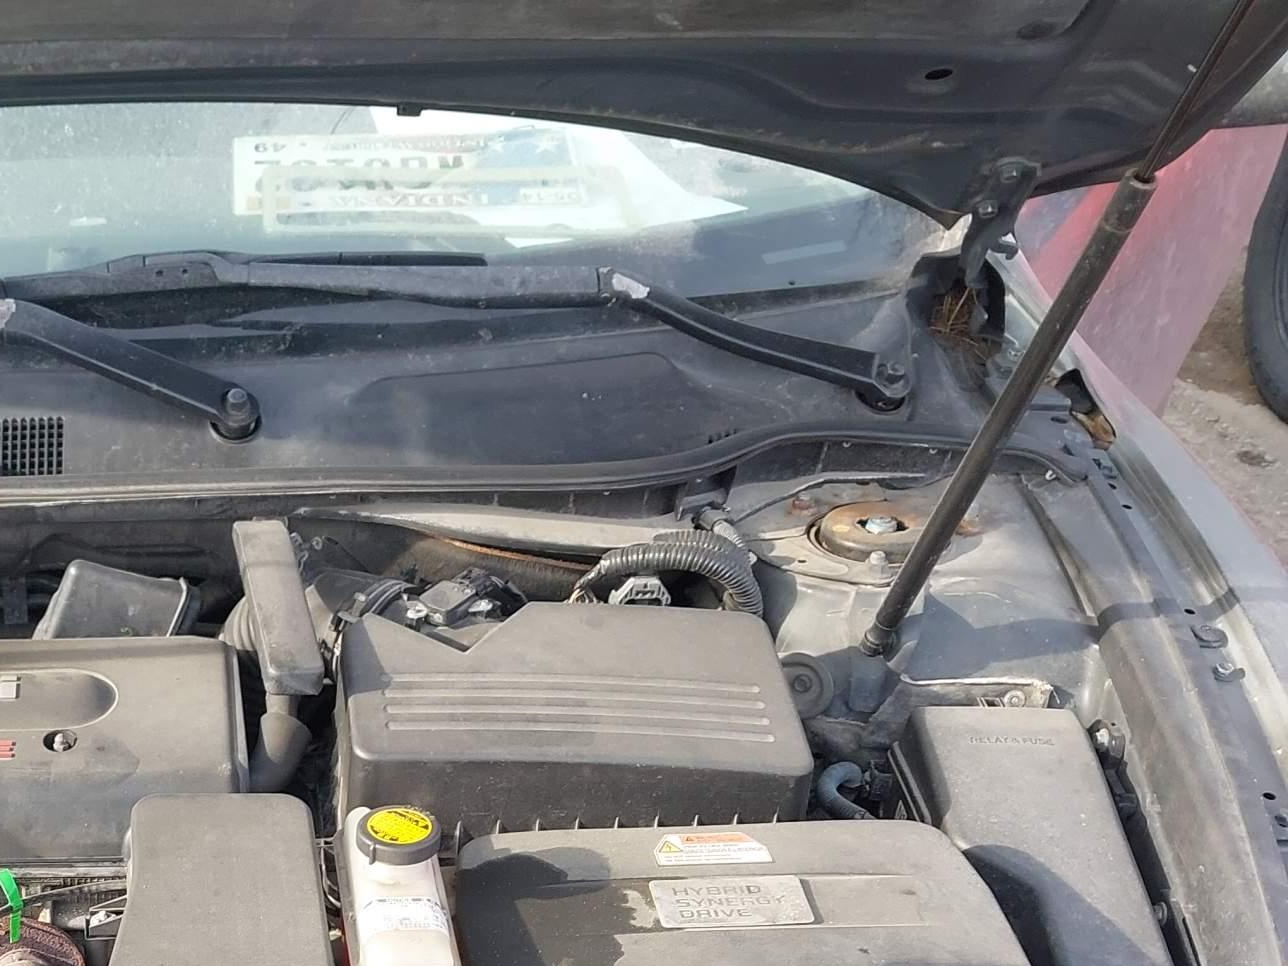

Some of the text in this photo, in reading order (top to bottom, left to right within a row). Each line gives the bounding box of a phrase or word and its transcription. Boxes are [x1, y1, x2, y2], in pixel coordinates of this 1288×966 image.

[334, 193, 491, 207] INDIANA
[968, 735, 1008, 745] RELAY
[1023, 736, 1056, 746] FUSE
[671, 885, 762, 897] HYBRID
[674, 895, 786, 908] SYNERGY
[679, 908, 754, 919] DRIVE
